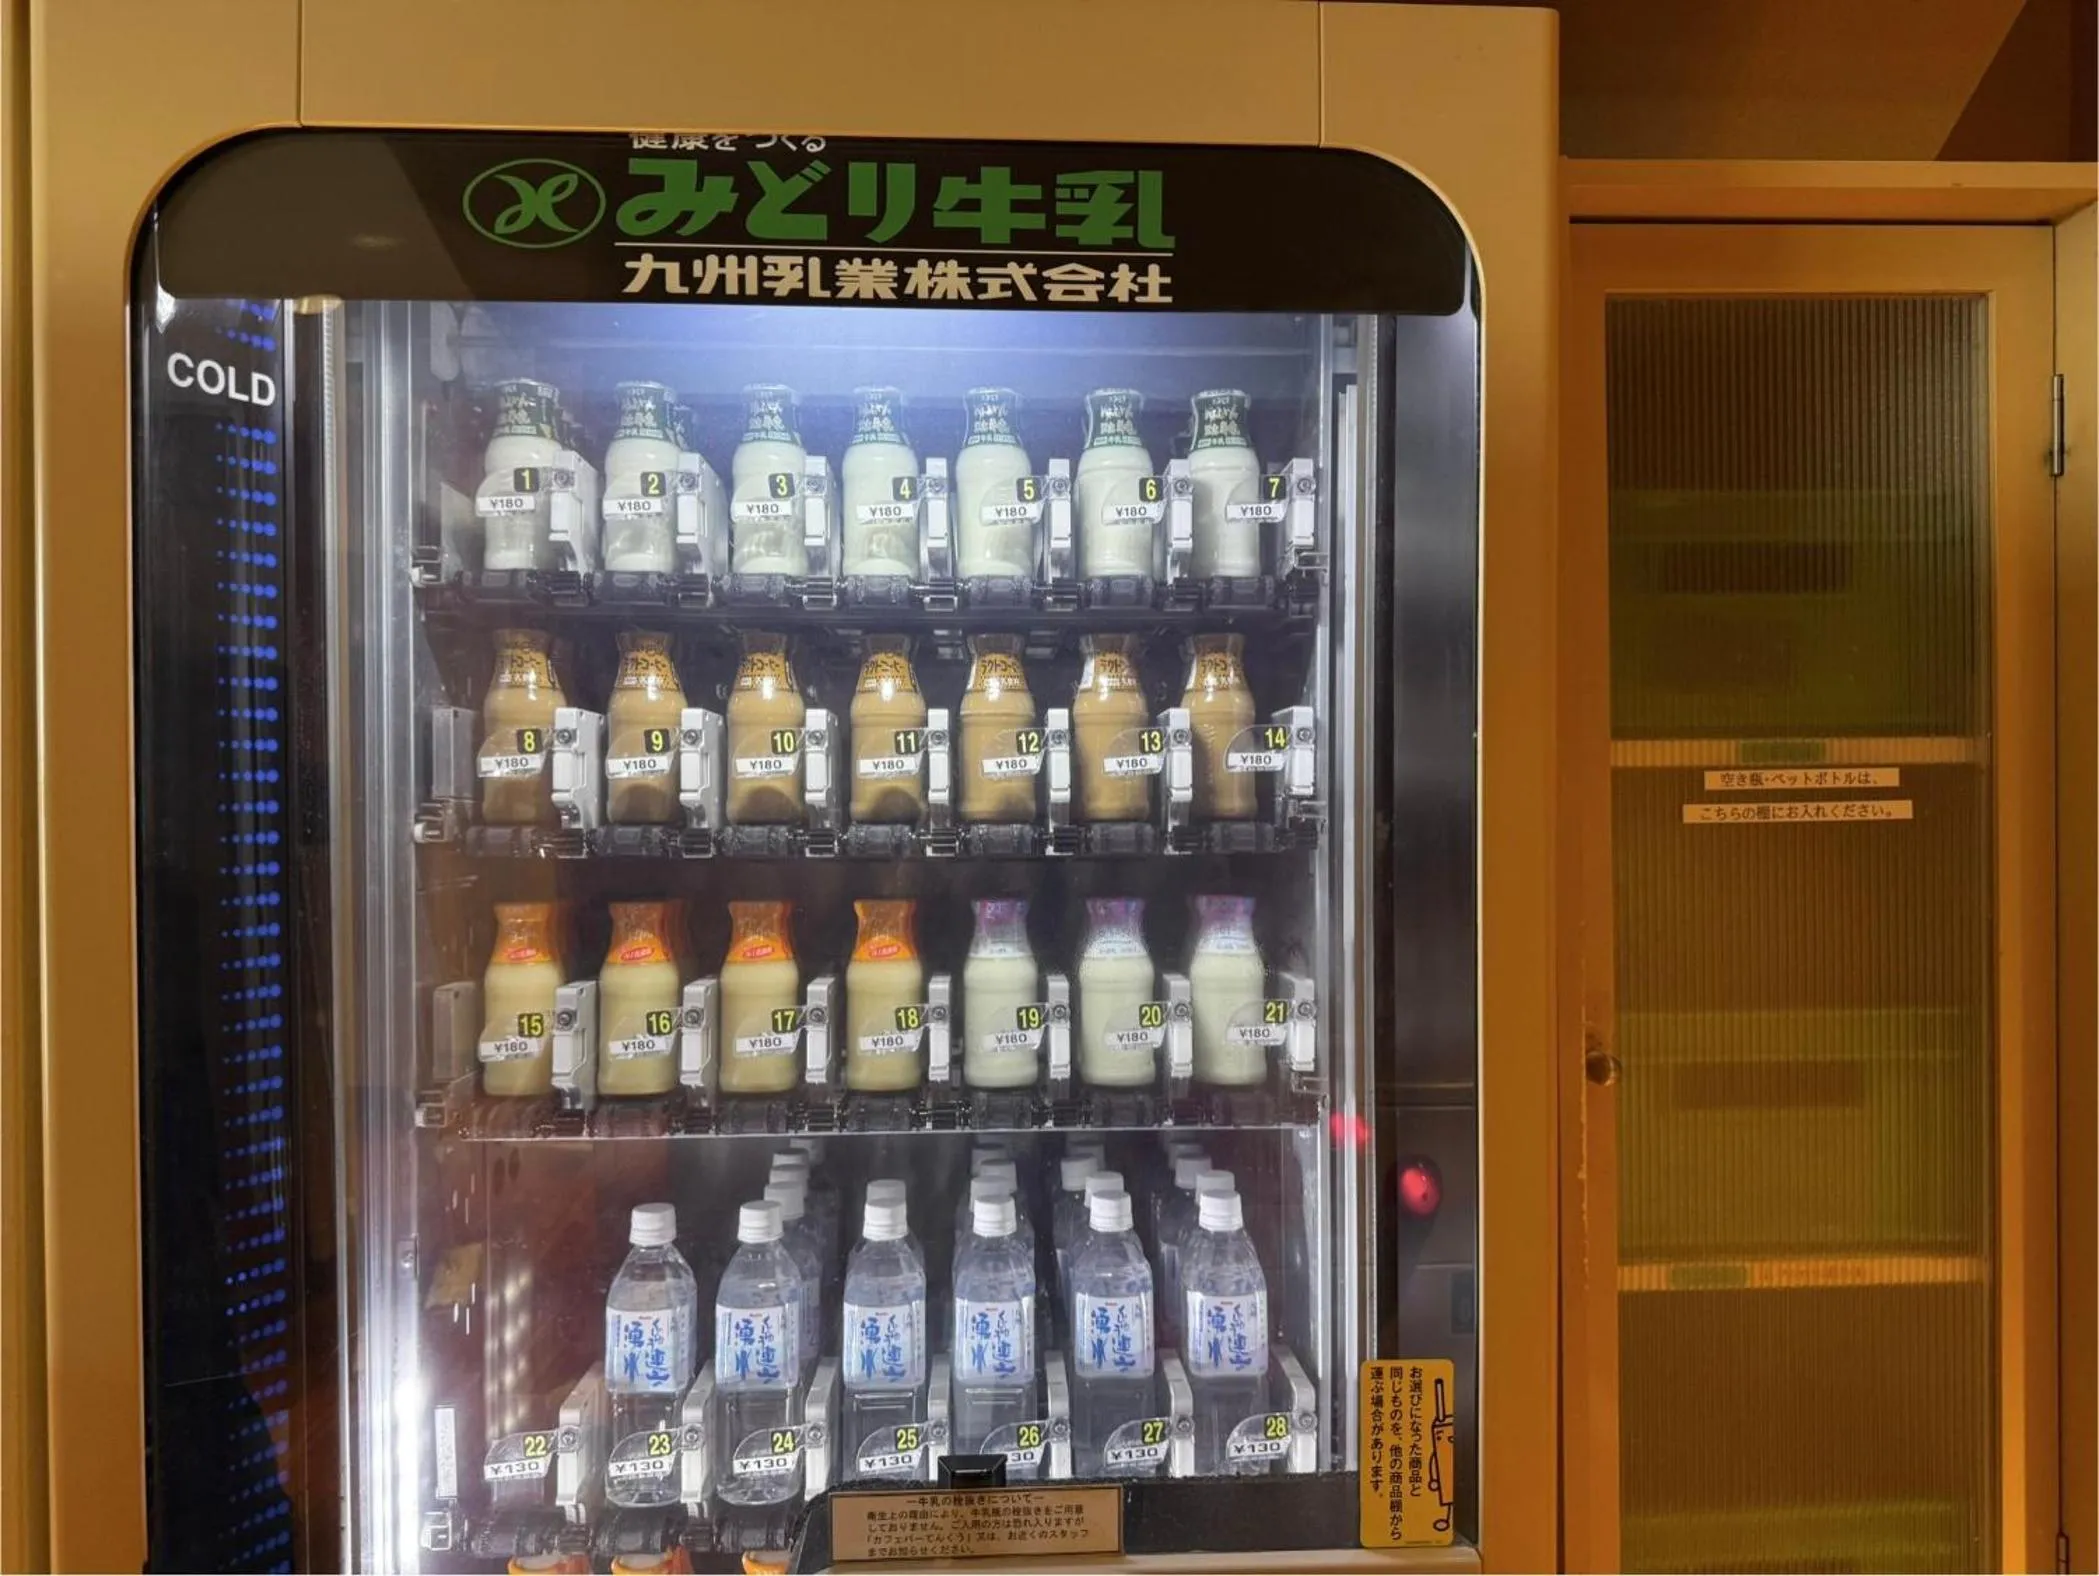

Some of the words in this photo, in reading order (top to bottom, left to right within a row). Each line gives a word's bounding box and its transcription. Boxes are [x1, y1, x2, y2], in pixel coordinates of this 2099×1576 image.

[615, 157, 1176, 249] みどり牛乳
[622, 253, 1174, 303] 九州乳業株式会社
[167, 352, 276, 407] COLD
[522, 470, 531, 490] 1
[648, 473, 659, 495] 2
[776, 475, 787, 496] 3
[899, 479, 910, 499] 4
[1023, 479, 1035, 500] 5
[1146, 479, 1157, 500] 6
[1268, 478, 1280, 498] 7
[490, 498, 524, 509] ¥180
[617, 501, 652, 511] ¥180
[746, 503, 779, 514] ¥180
[869, 506, 901, 517] ¥180
[995, 506, 1027, 517] ¥180
[1115, 507, 1148, 517] ¥180
[1240, 506, 1273, 516] ¥180
[523, 731, 536, 752] 8
[651, 730, 664, 752] 9
[773, 732, 794, 752] 10
[896, 733, 917, 752] 11
[1018, 731, 1040, 753] 12
[1141, 731, 1161, 752] 13
[1264, 728, 1286, 748] 14
[494, 757, 529, 768] ¥180
[623, 759, 657, 770] ¥180
[750, 760, 783, 770] ¥180
[872, 760, 904, 770] ¥180
[996, 759, 1028, 769] ¥180
[1116, 758, 1149, 769] ¥180
[1240, 755, 1272, 765] ¥180
[1700, 803, 1893, 821] こちらの棚にお入れください。
[773, 1010, 795, 1031] 17
[897, 1008, 919, 1028] 18
[1018, 1007, 1040, 1029] 19
[1140, 1005, 1162, 1025] 20
[1265, 1001, 1286, 1022] 21
[520, 1015, 542, 1035] 15
[648, 1012, 671, 1034] 16
[749, 1038, 782, 1048] ¥180
[872, 1037, 904, 1047] ¥180
[996, 1033, 1028, 1044] ¥180
[1116, 1032, 1149, 1043] ¥180
[1239, 1029, 1271, 1039] ¥180
[494, 1041, 528, 1053] ¥180
[622, 1040, 656, 1050] ¥180
[1018, 1426, 1040, 1447] 26
[1143, 1421, 1164, 1443] 27
[1266, 1416, 1287, 1437] 28
[1370, 1366, 1384, 1498] 運ぶ場合があります。
[1409, 1366, 1423, 1497] お選びになった商品と
[524, 1436, 547, 1457] 22
[649, 1435, 671, 1455] 23
[773, 1431, 794, 1453] 24
[897, 1429, 918, 1449] 25
[1234, 1442, 1282, 1455] ¥130
[864, 1455, 913, 1468] ¥130
[1011, 1451, 1035, 1462] 30
[1109, 1448, 1158, 1461] ¥130
[1389, 1366, 1403, 1541] 同じものを、他の商品棚から
[490, 1462, 540, 1475] ¥130
[615, 1460, 664, 1473] ¥130
[739, 1458, 788, 1470] ¥130
